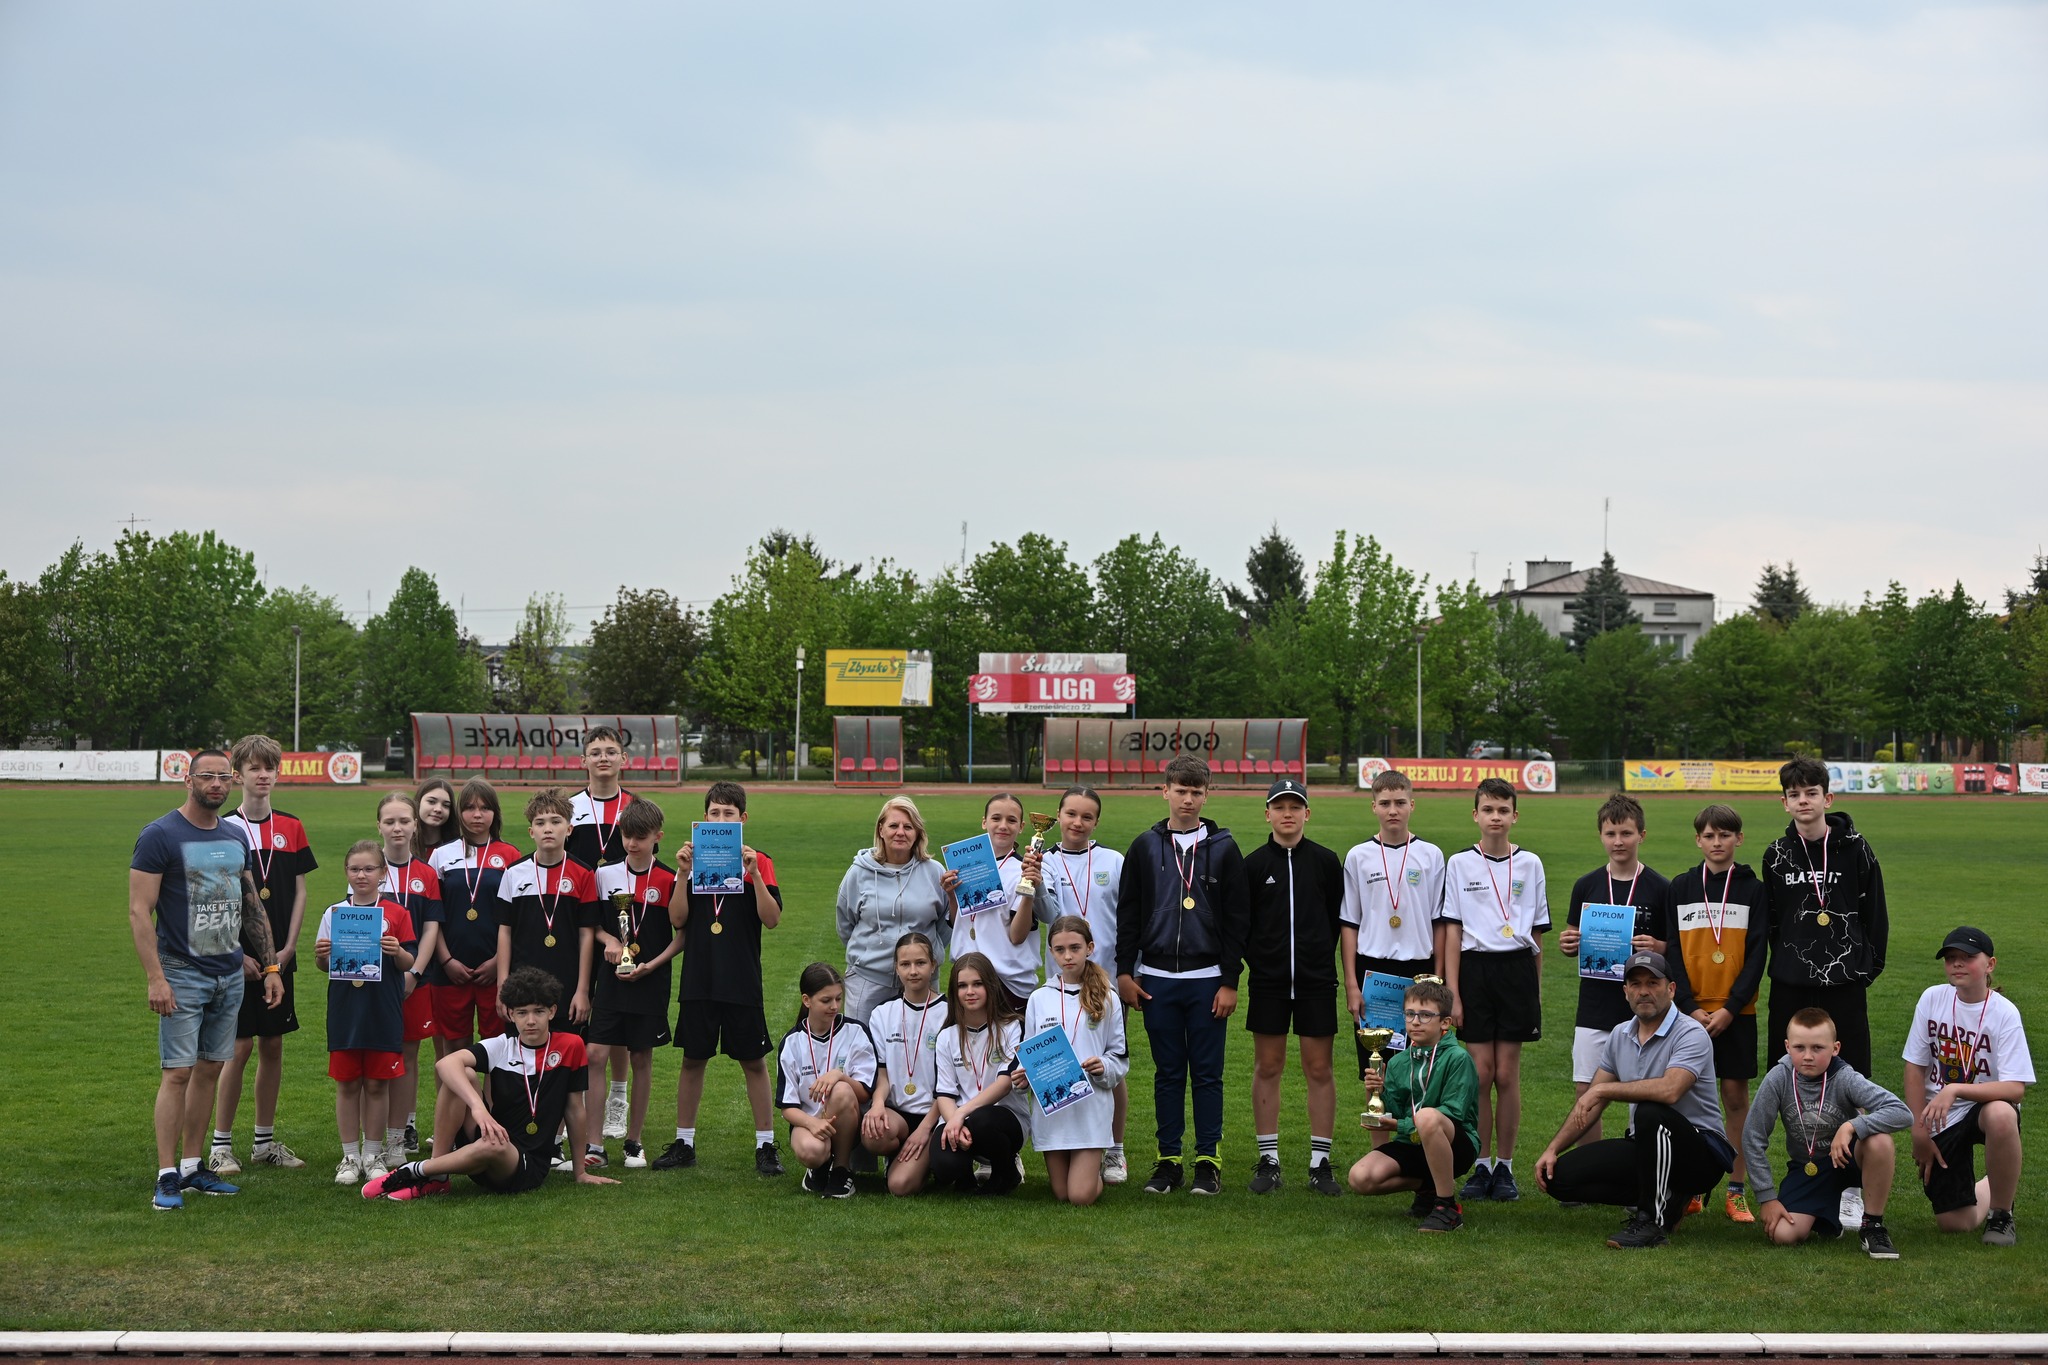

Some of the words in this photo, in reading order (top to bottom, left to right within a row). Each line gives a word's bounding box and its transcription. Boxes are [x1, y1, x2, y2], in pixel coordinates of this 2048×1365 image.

[847, 661, 889, 675] Zbyszko
[1039, 678, 1096, 701] LIGA
[1082, 703, 1092, 711] 22
[0, 760, 43, 773] exans
[280, 760, 324, 776] NAMI
[1396, 765, 1458, 782] TRENUJ
[1462, 766, 1473, 783] Z
[1477, 766, 1519, 784] NAMI
[952, 843, 983, 858] DYPLOM
[1785, 871, 1824, 885] BLAZE
[196, 904, 218, 913] TAKE
[219, 902, 229, 911] ME
[194, 911, 242, 931] BEAC
[340, 913, 373, 921] DYPLOM
[1591, 910, 1625, 920] DYPLOM
[1373, 979, 1406, 991] DYPLOM
[1025, 1035, 1058, 1055] DYPLOM
